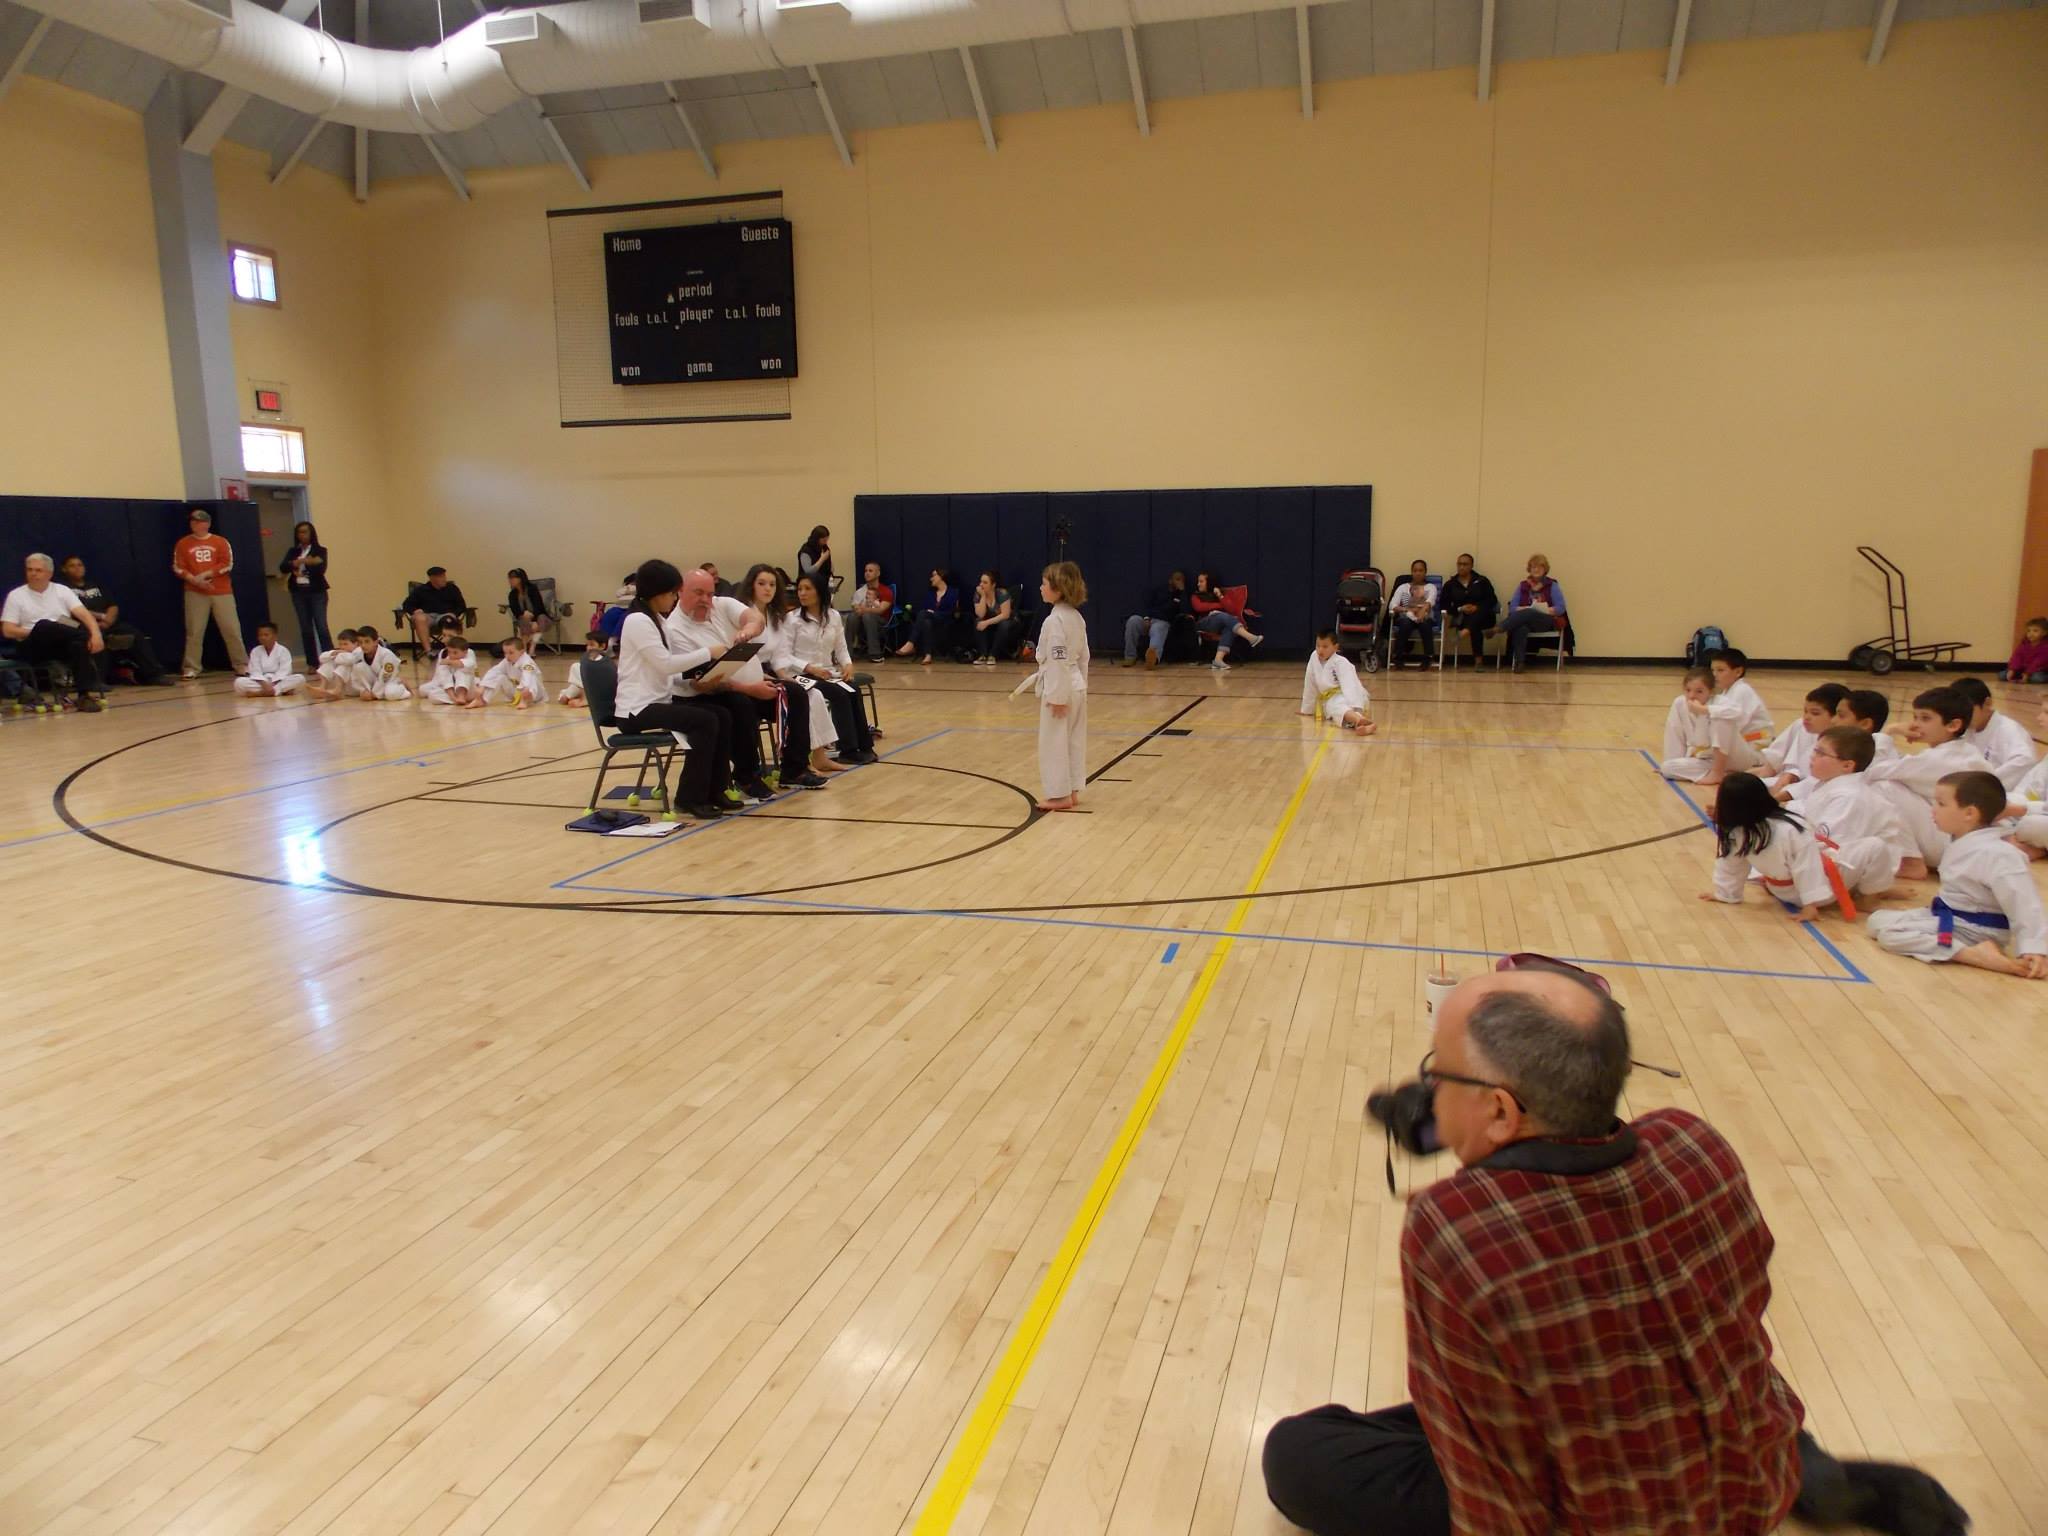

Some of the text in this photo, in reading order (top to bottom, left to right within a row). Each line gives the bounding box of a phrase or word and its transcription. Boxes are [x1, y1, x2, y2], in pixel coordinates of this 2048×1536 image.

[741, 226, 779, 242] Guests
[613, 237, 642, 252] Home
[678, 281, 713, 301] period
[680, 307, 714, 323] player
[755, 303, 781, 318] fouls
[615, 312, 639, 326] fouls
[621, 366, 641, 377] won
[687, 361, 713, 376] game
[761, 358, 782, 370] won
[195, 549, 211, 562] 92
